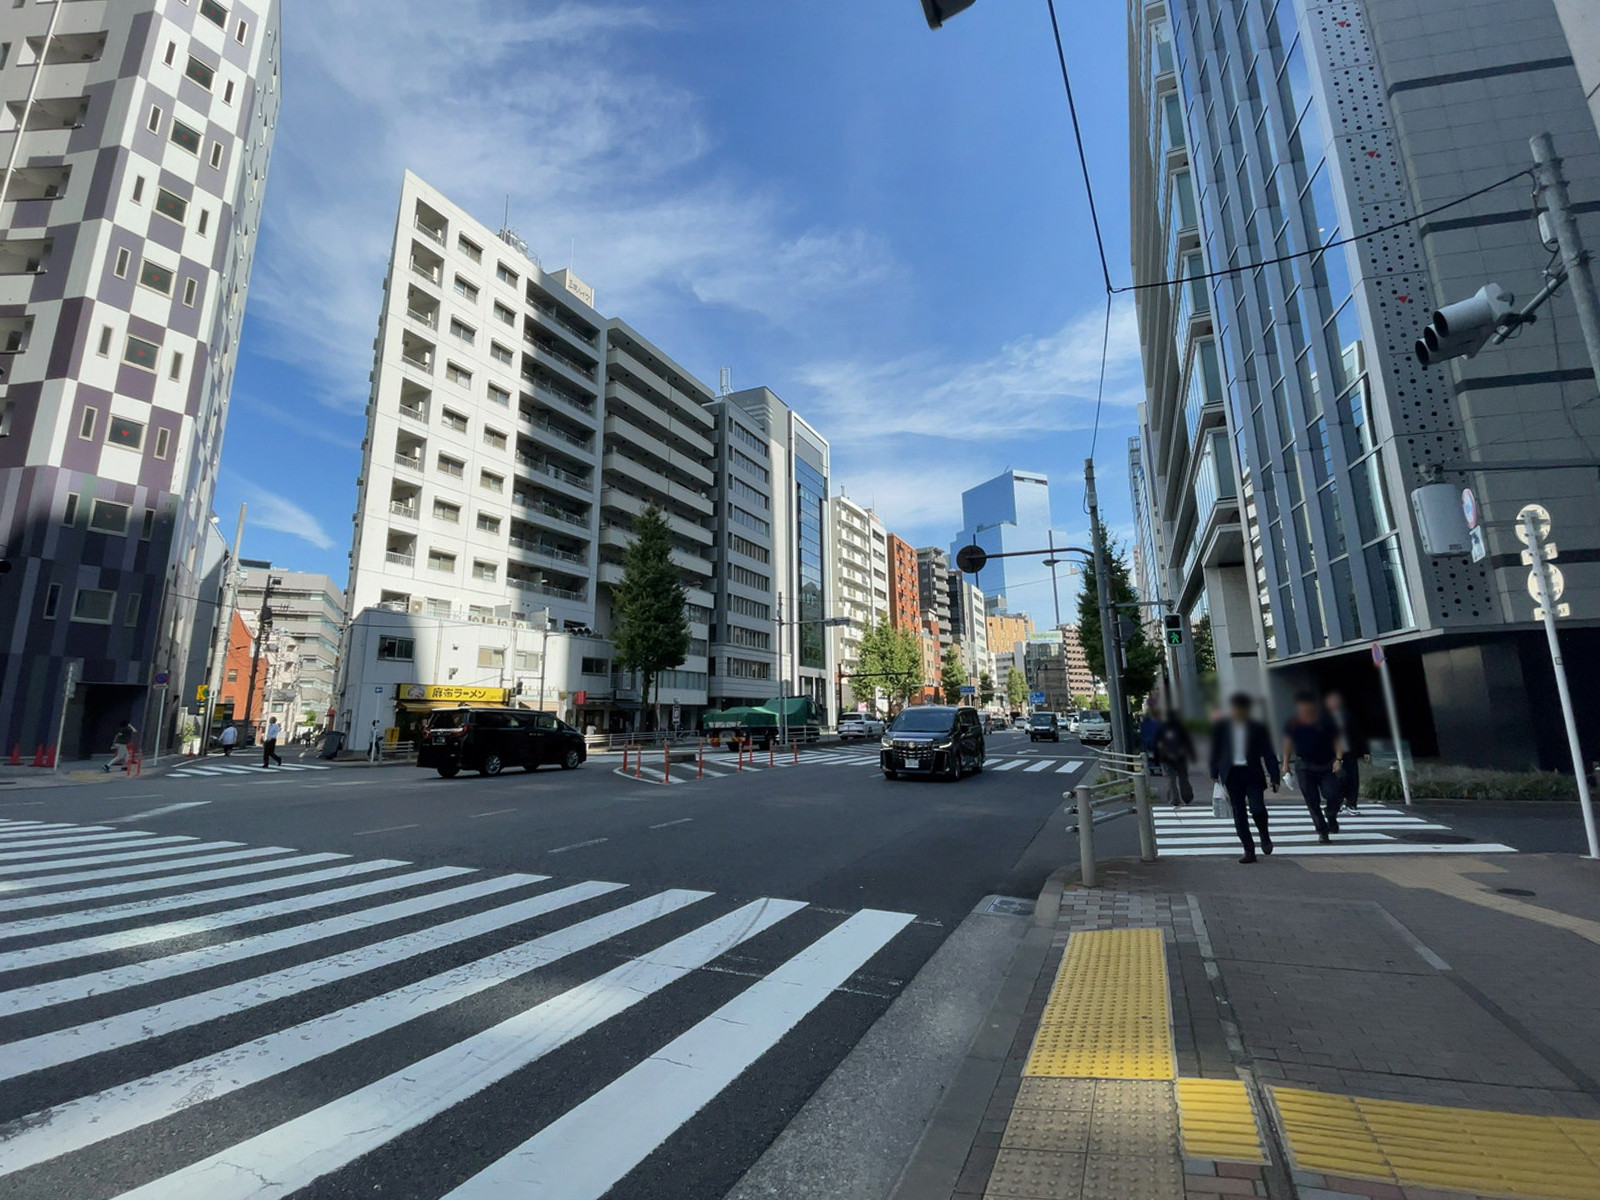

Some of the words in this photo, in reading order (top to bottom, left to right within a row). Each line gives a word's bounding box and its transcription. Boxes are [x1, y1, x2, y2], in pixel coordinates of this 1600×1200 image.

[432, 687, 486, 699] 麻布ラーメン
